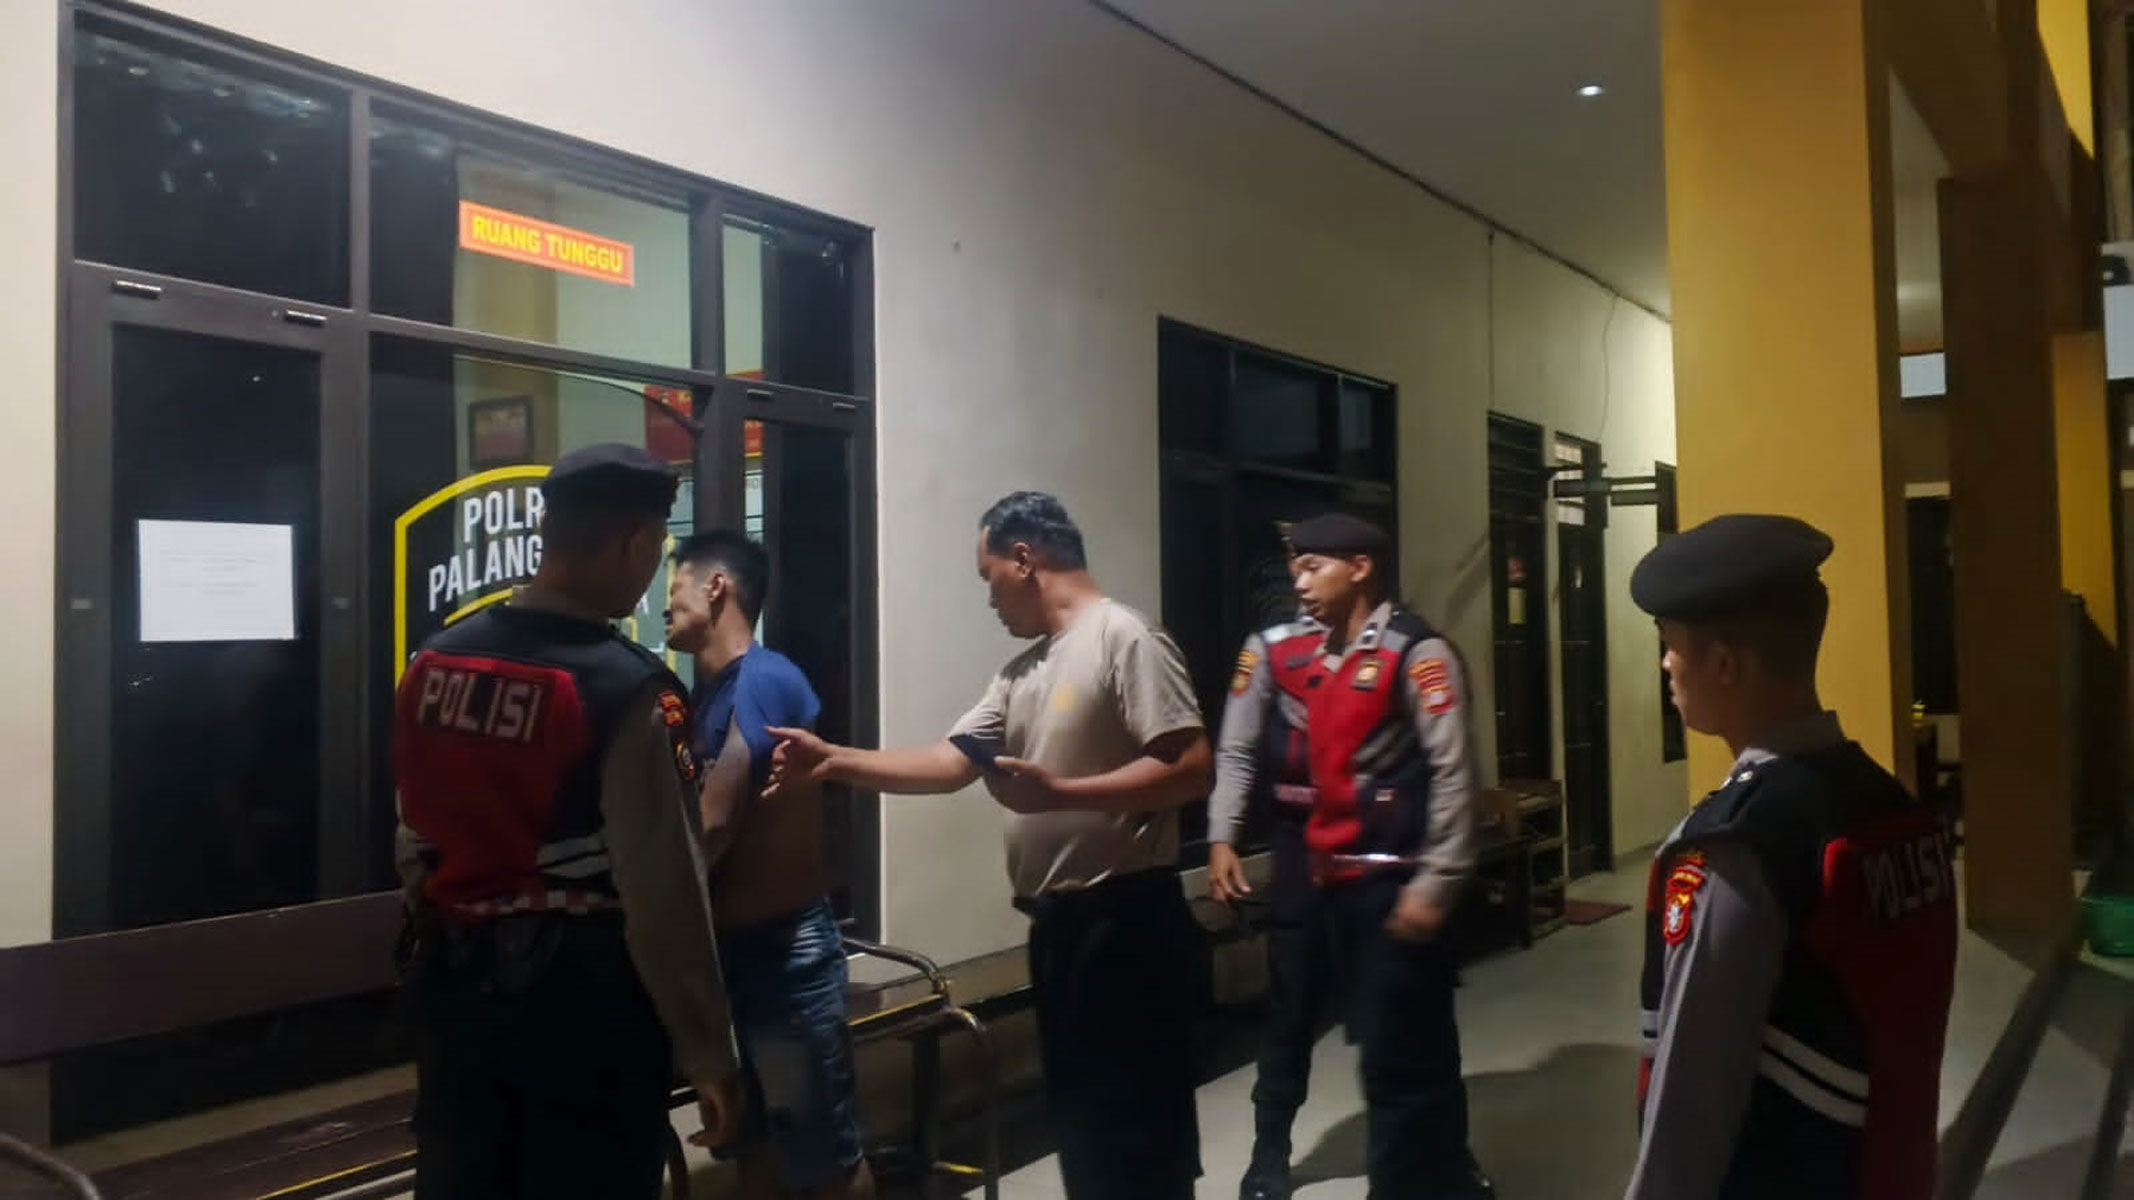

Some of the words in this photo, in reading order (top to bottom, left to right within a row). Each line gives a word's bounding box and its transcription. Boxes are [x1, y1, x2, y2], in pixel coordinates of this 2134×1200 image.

[472, 213, 541, 254] RUANG
[545, 233, 624, 274] TUNGGU
[464, 486, 544, 543] POLR
[429, 534, 543, 612] PALANG
[417, 670, 543, 744] POLISI
